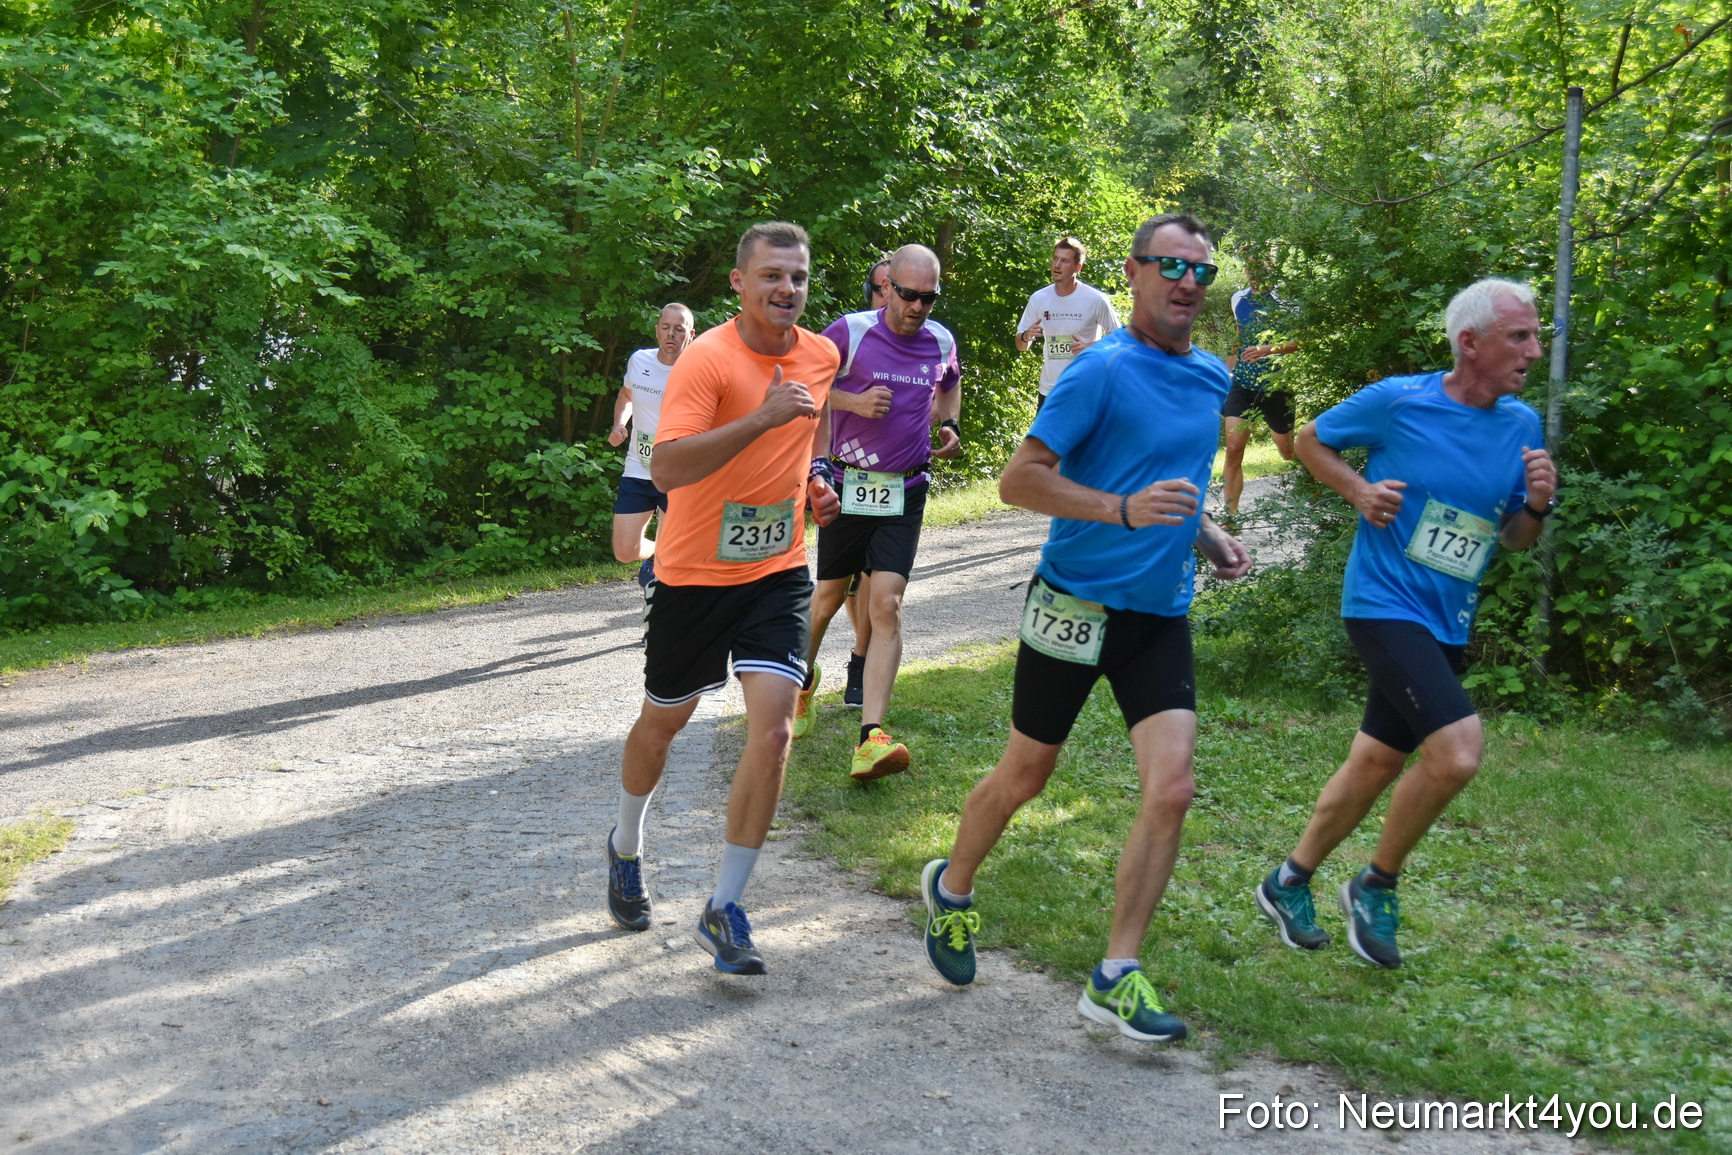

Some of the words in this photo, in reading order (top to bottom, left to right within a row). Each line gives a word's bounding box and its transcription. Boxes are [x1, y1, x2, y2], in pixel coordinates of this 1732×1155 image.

[1049, 343, 1072, 353] 2150
[873, 371, 889, 380] WIR
[891, 374, 911, 383] SIND
[912, 377, 932, 386] LILA.
[632, 382, 661, 395] RUPPRECHT
[639, 443, 654, 457] 20
[856, 487, 890, 504] 912
[728, 521, 786, 546] 2313
[1428, 526, 1481, 562] 1737
[1032, 607, 1092, 645] 1738
